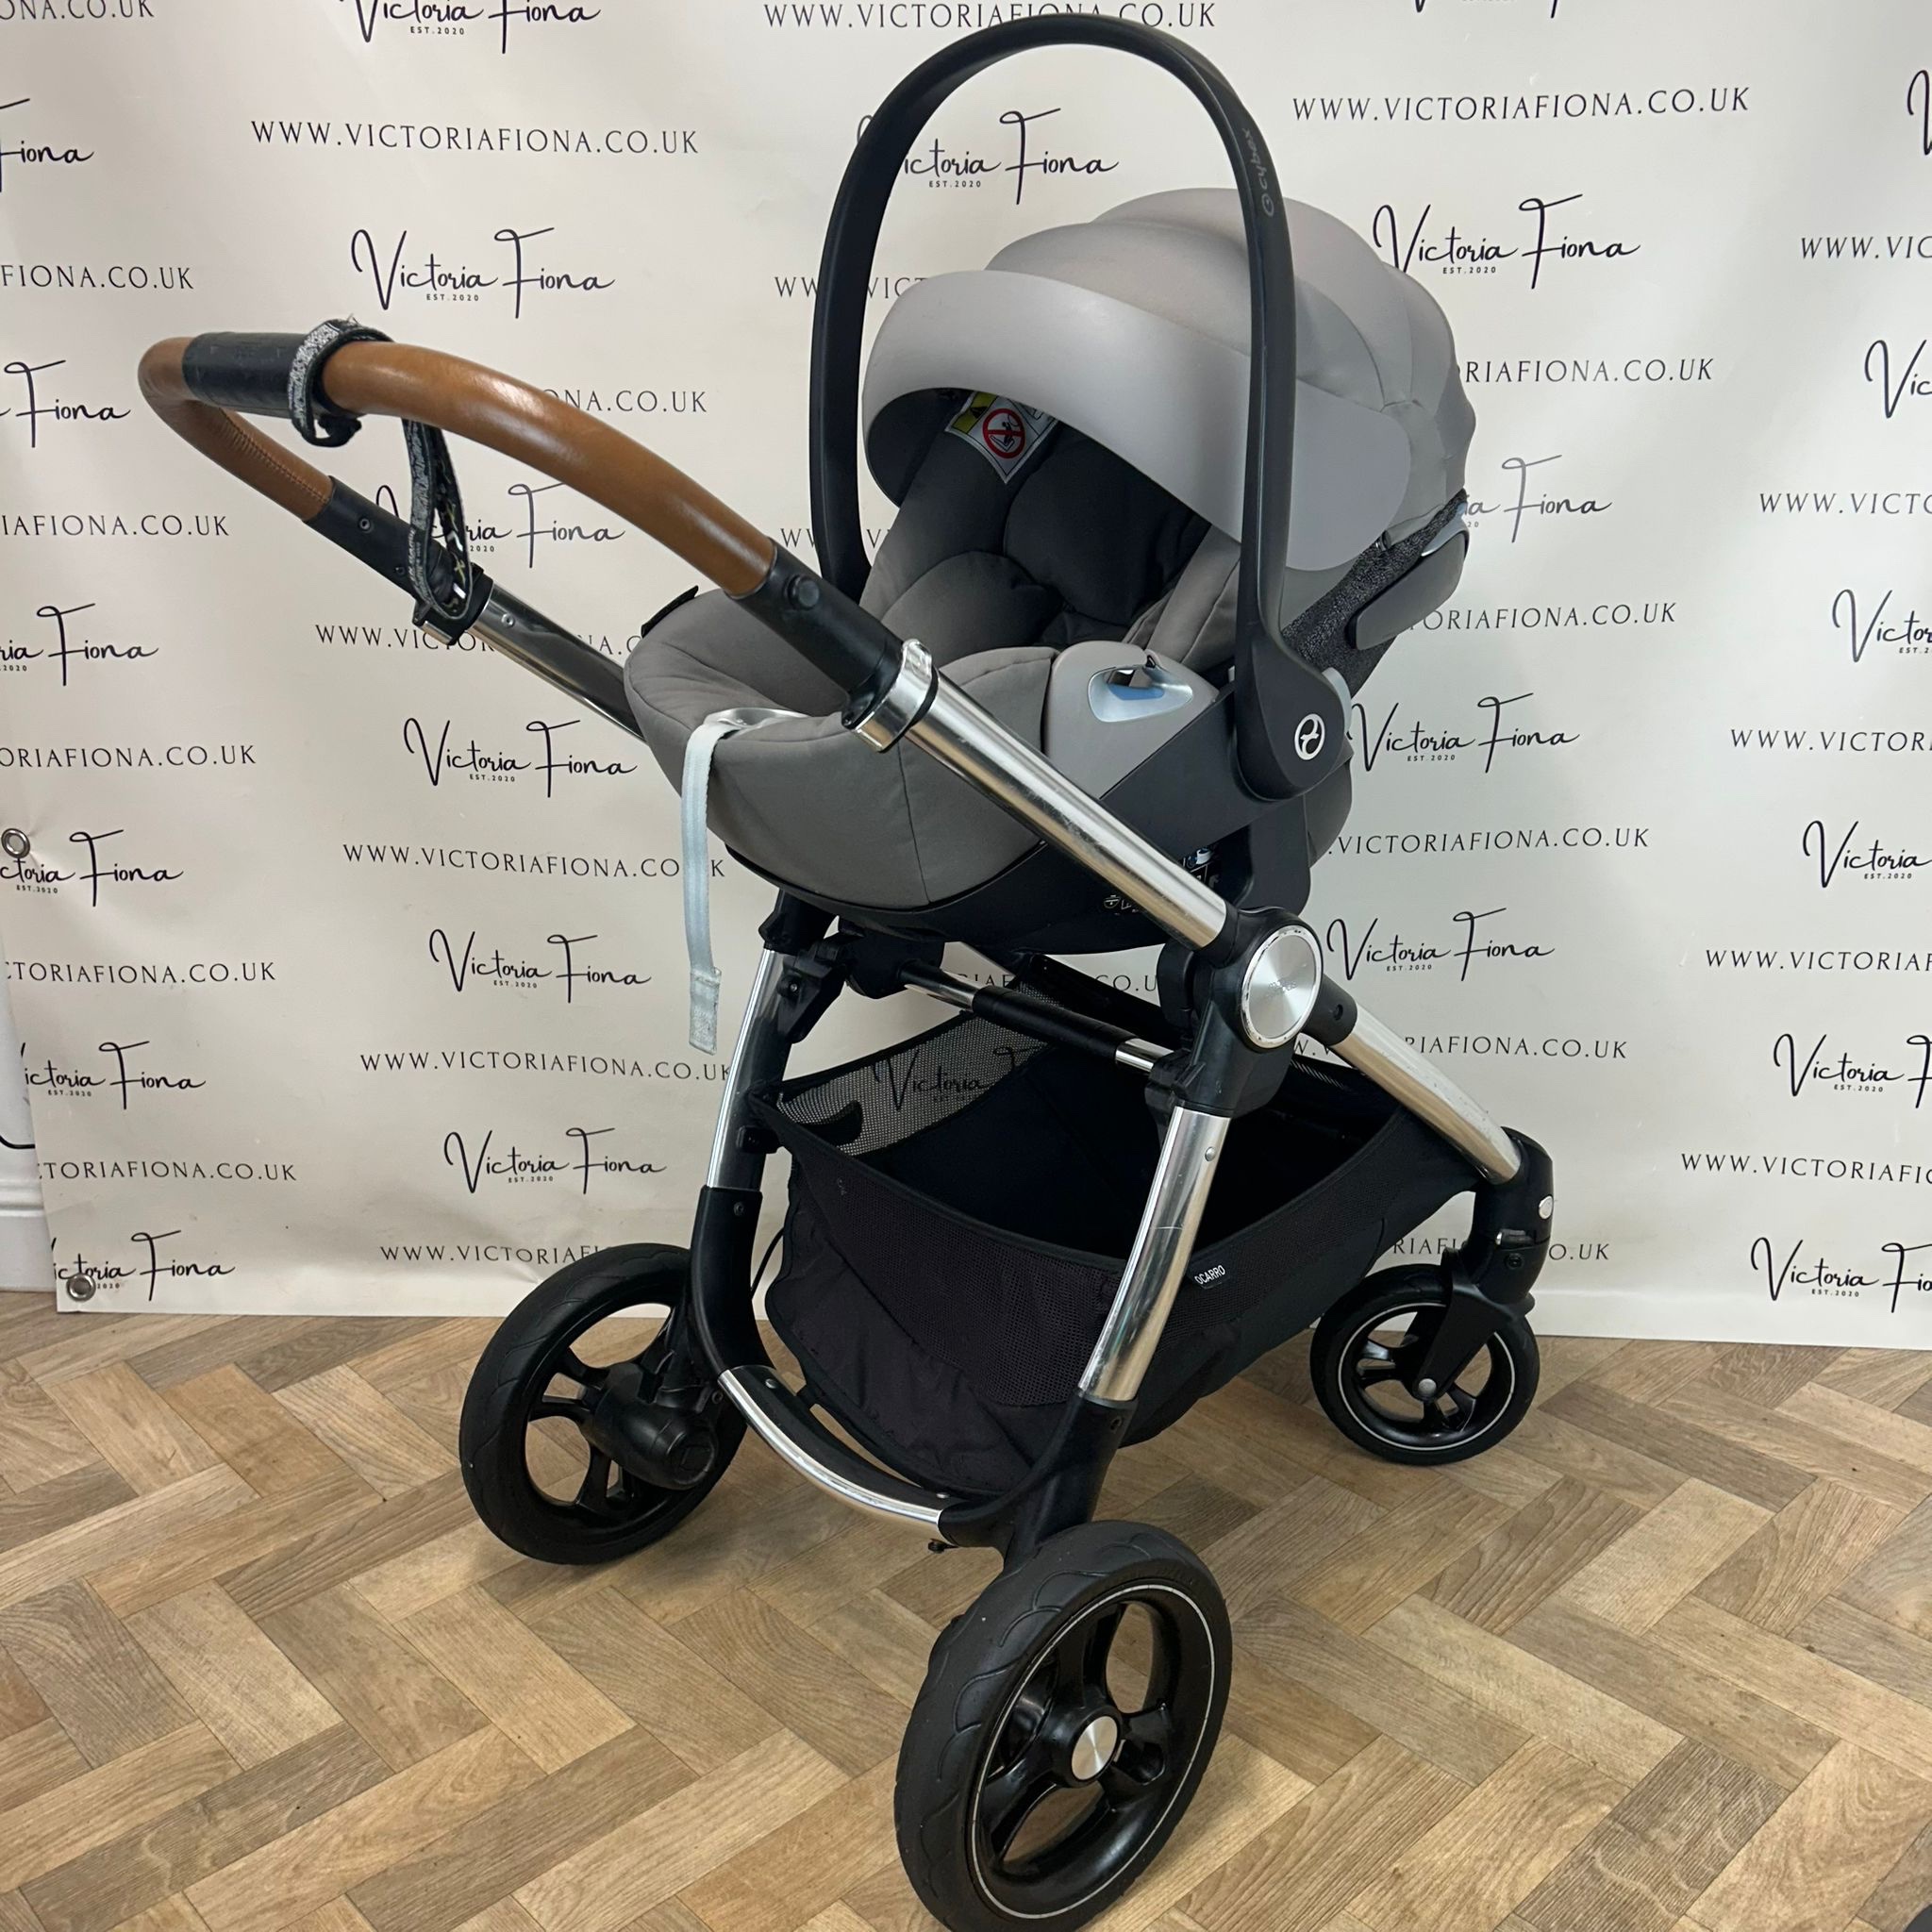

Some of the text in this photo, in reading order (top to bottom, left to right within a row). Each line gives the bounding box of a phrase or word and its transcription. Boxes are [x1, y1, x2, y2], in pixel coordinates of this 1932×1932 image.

[409, 25, 465, 35] EST.2020
[251, 120, 697, 154] WWW.VICTORIAFIONA.CO.UK
[1292, 87, 1750, 121] WWW.VICTORIAFIONA.CO.UK
[1000, 108, 1120, 206] Fiona
[351, 227, 616, 319] Victoria Fiona
[1373, 194, 1641, 289] Victoria Fiona
[1442, 266, 1497, 275] EST.2020
[426, 293, 479, 302] EST.2020
[4, 359, 131, 448] Fiona
[1466, 358, 1714, 383] RIAFIONA.CO.UK
[508, 481, 625, 569] Fiona
[1501, 454, 1613, 543] Fiona
[36, 603, 159, 687] Fiona
[1409, 602, 1676, 631] ORIAFIONA.CO.UK
[404, 718, 638, 798] Victoria Fiona
[1477, 692, 1580, 774] Fiona
[469, 774, 516, 782] EST.2020
[69, 829, 184, 908] Fiona
[342, 843, 725, 878] WWW.VICTORIAFIONA.COK
[1802, 820, 1932, 889] Victoria
[6, 961, 275, 984] TORIAFIONA.CO.UK
[429, 928, 652, 1003] Victoria Fiona
[1326, 908, 1555, 981] Victoria Fiona
[21, 1041, 207, 1110] ictoria Fiona
[360, 1051, 730, 1081] WWW.VICTORIAFIONA.CO.UK
[1774, 1034, 1905, 1096] Victoria
[38, 1161, 296, 1181] TORIAFIONA.CO.UK
[444, 1127, 667, 1194] Victoria Fiona
[51, 1230, 236, 1301] ictoria Fiona
[1193, 1264, 1225, 1285] OCARRO
[1751, 1237, 1880, 1301] Victoria
